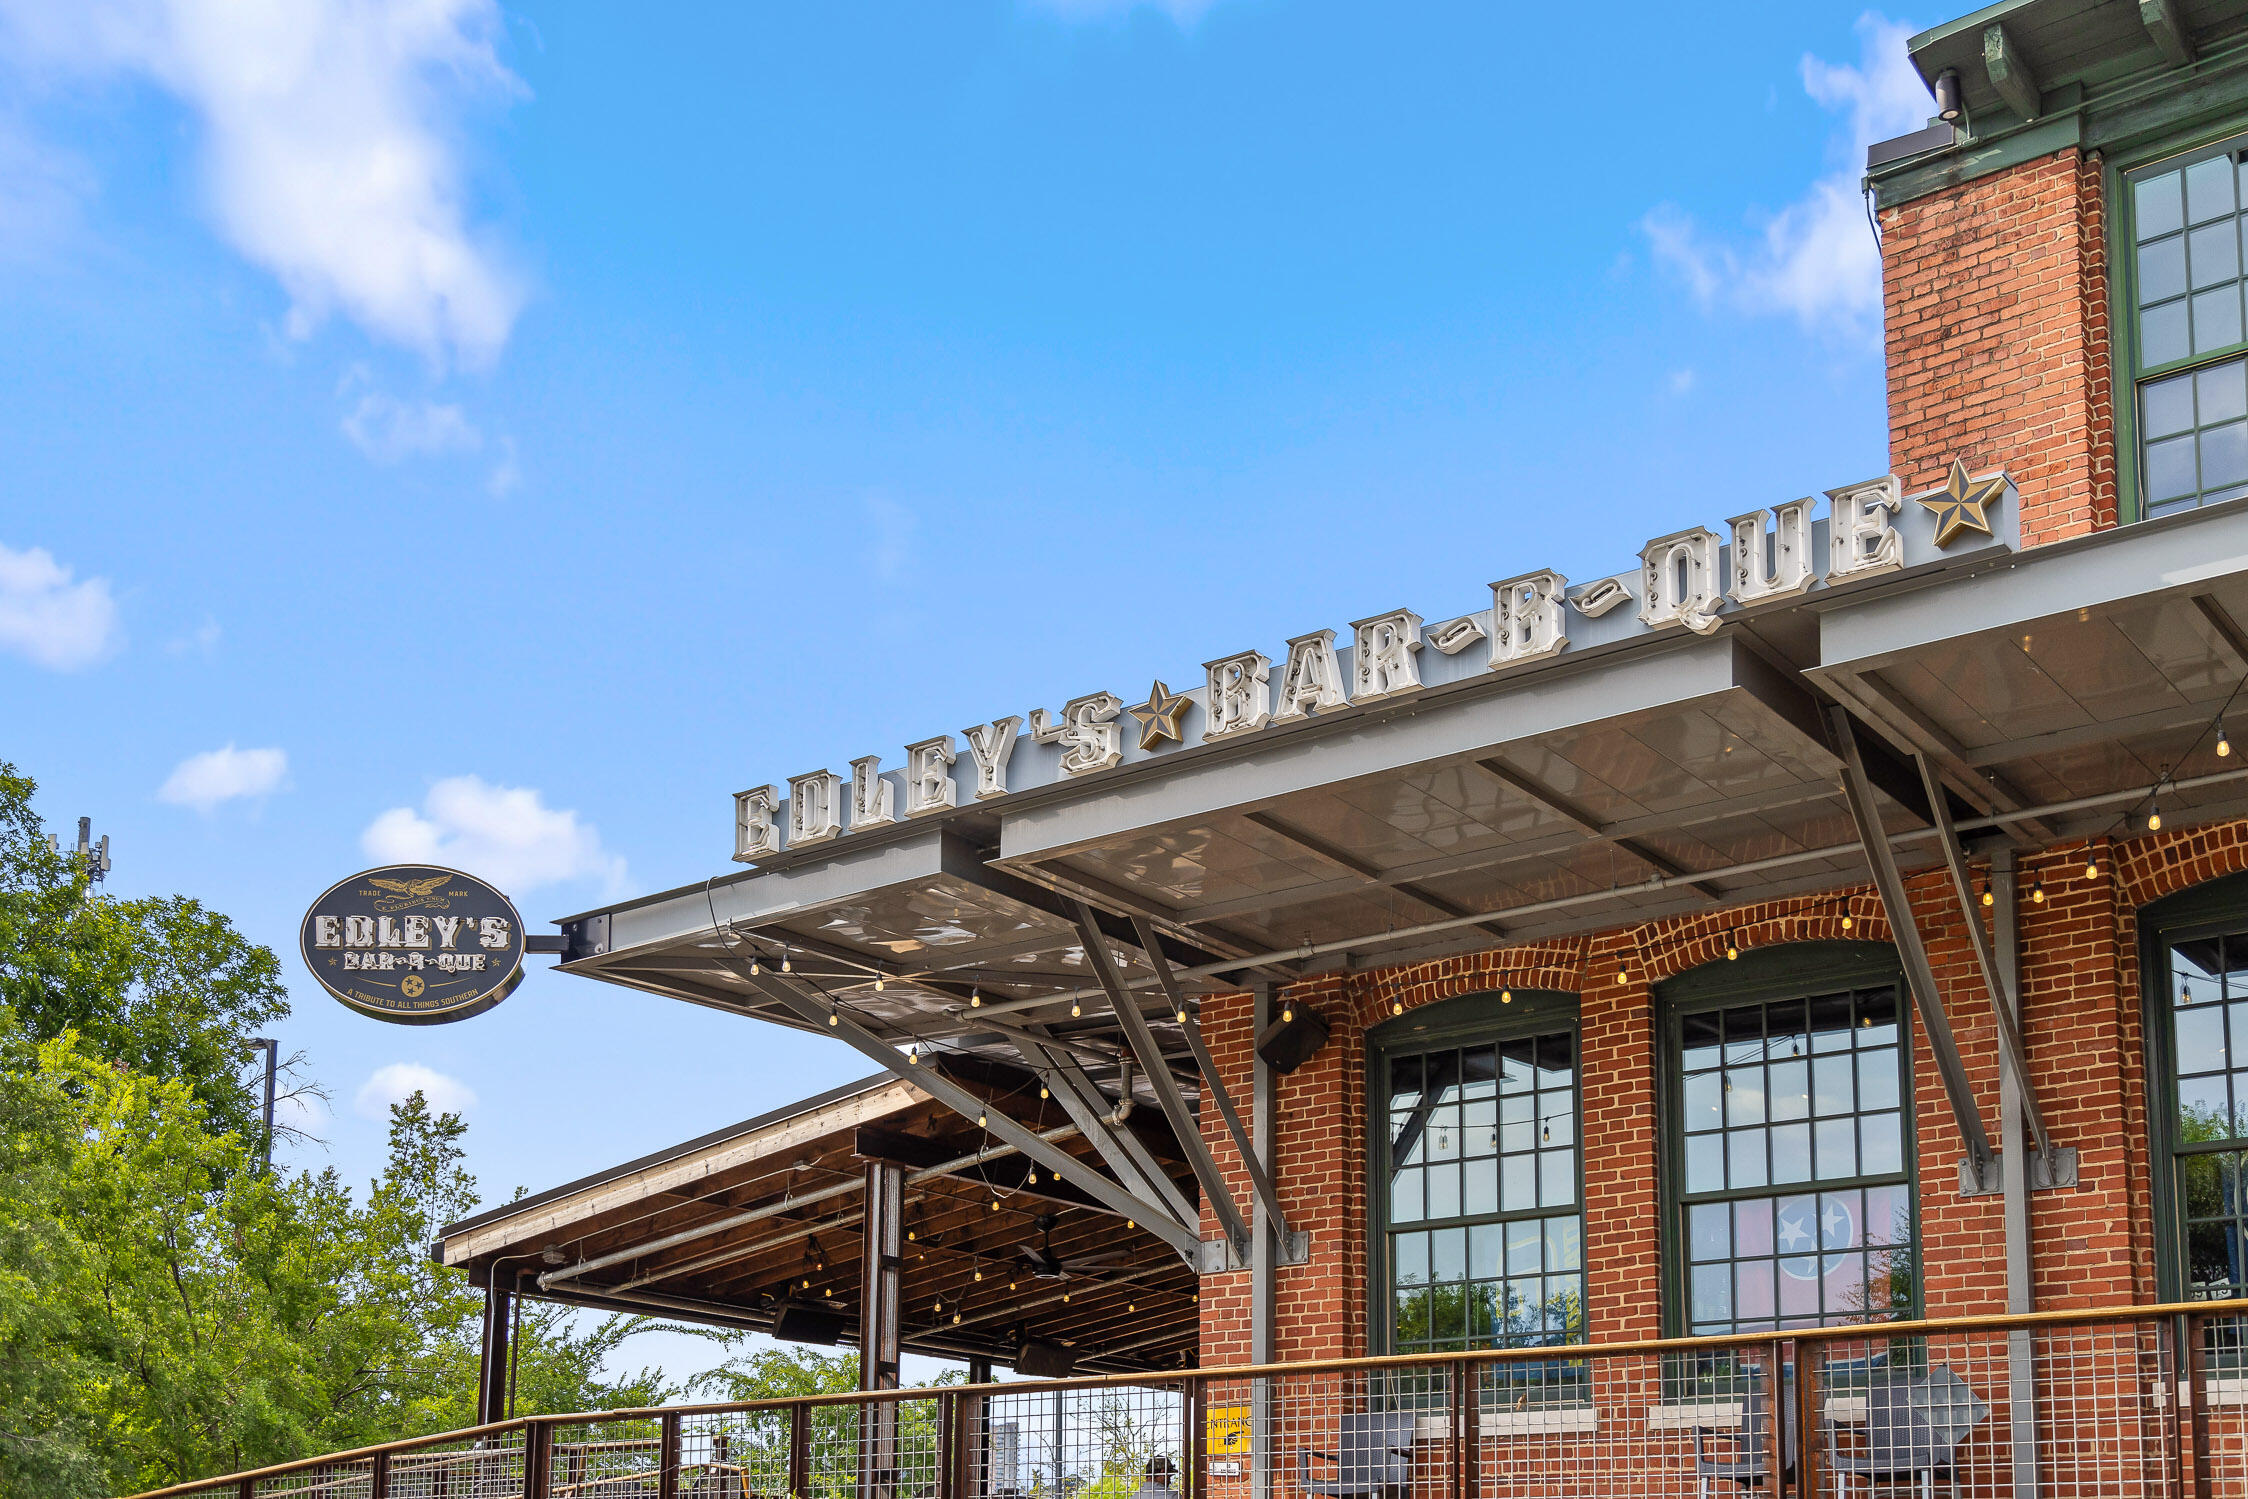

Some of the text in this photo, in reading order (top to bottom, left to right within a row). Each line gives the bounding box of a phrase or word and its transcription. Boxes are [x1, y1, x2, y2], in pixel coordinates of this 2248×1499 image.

[731, 690, 1124, 863] EDLEY'S
[314, 915, 512, 951] EDLEY'S
[346, 988, 479, 1009] A TRIBUTE TO ALL THINGS SOUTHERN
